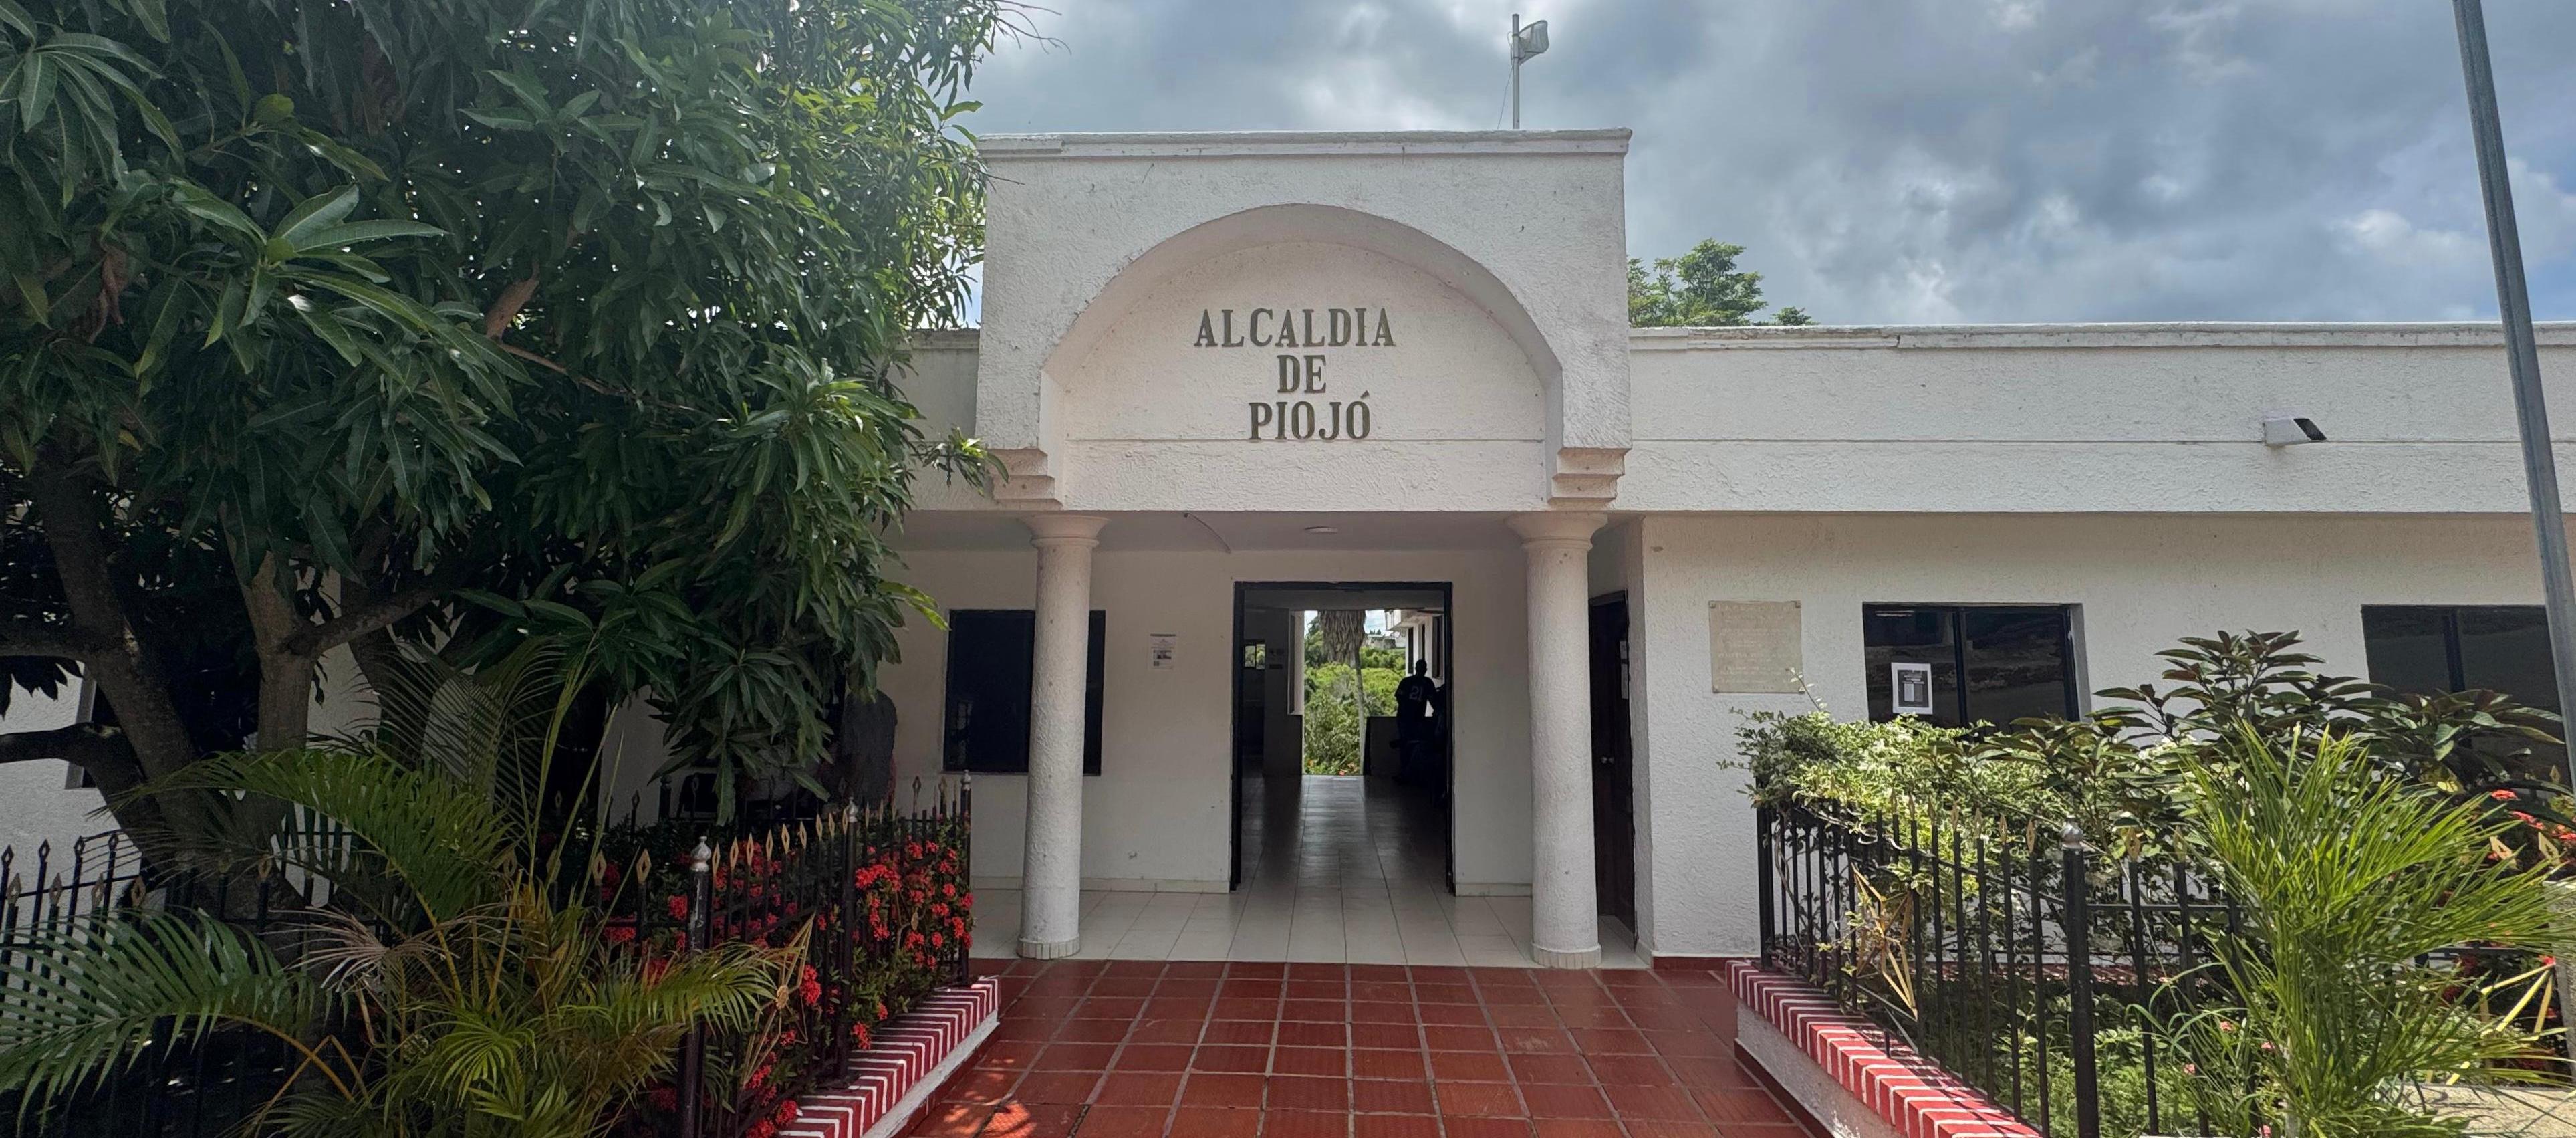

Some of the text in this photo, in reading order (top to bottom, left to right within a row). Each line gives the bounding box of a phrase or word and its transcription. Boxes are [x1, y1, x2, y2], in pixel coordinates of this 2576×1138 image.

[1194, 308, 1396, 347] ALCALDIA
[1277, 354, 1327, 394] DE
[1249, 390, 1371, 441] PIOJÓ
[1408, 685, 1423, 701] 21
